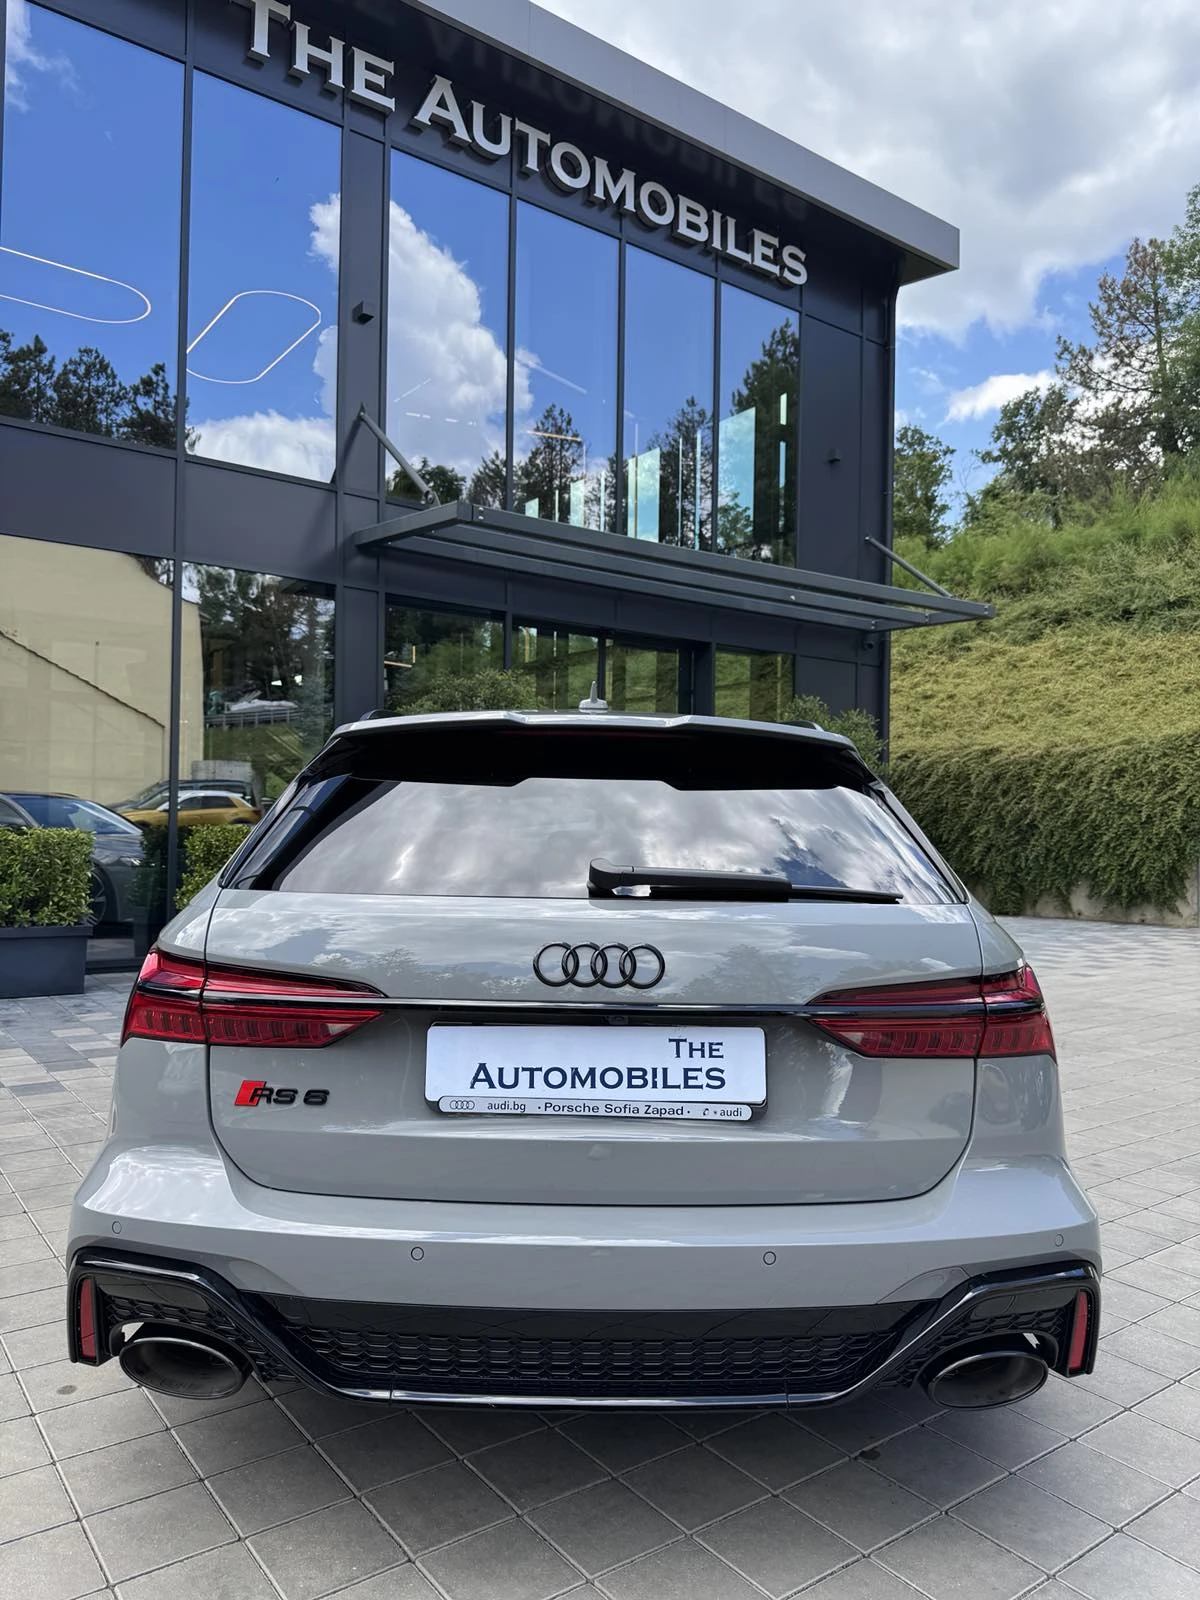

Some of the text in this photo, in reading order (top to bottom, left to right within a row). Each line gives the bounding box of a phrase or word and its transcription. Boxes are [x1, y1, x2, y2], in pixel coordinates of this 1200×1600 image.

[246, 0, 395, 113] THE
[413, 74, 809, 287] AUTOMOBILES
[668, 1037, 724, 1059] THE
[469, 1062, 726, 1090] AUTOMOBILES
[487, 1101, 526, 1113] audi.bg
[544, 1102, 600, 1113] Porsche
[604, 1103, 640, 1114] Sofia
[644, 1104, 684, 1117] Zapad
